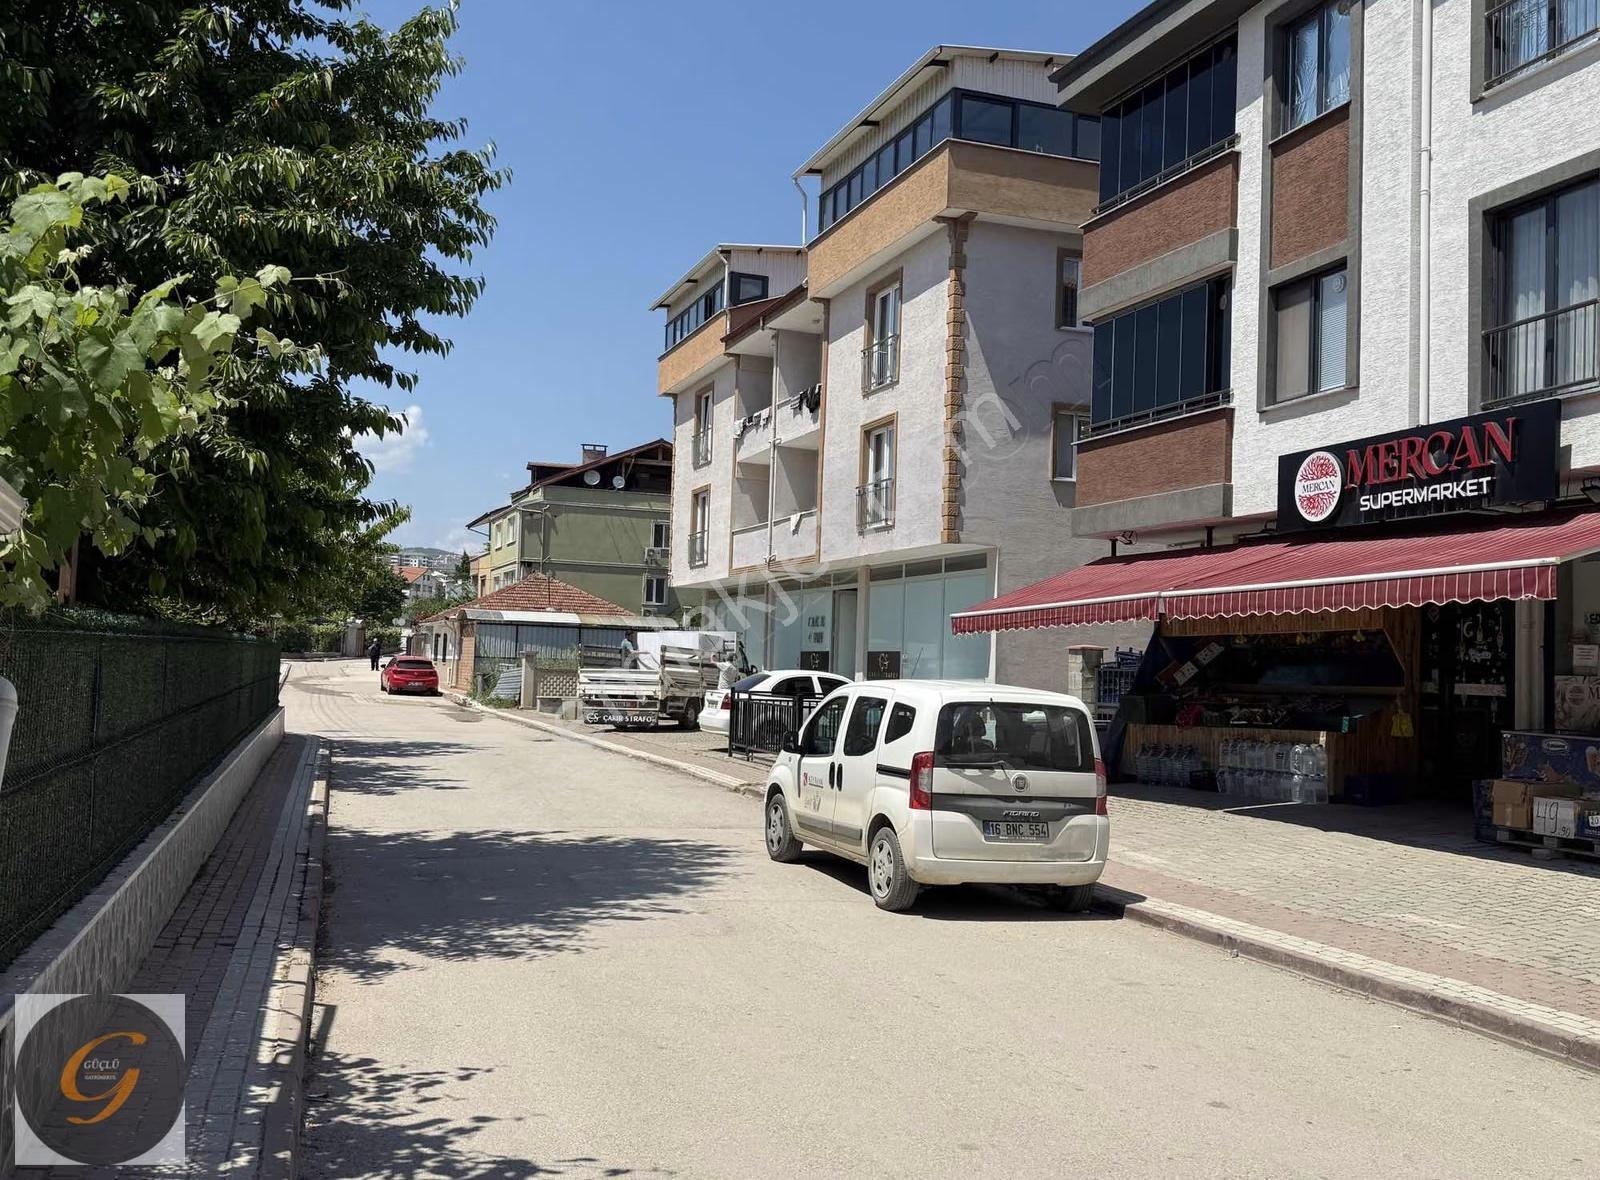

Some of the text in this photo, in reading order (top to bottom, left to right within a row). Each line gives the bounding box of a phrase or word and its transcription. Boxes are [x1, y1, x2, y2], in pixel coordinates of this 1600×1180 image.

[1345, 418, 1517, 489] MERCAN
[1302, 480, 1335, 493] MERCAN
[1360, 477, 1492, 511] SUPERMARKET
[991, 823, 1046, 836] 16 BNC 554
